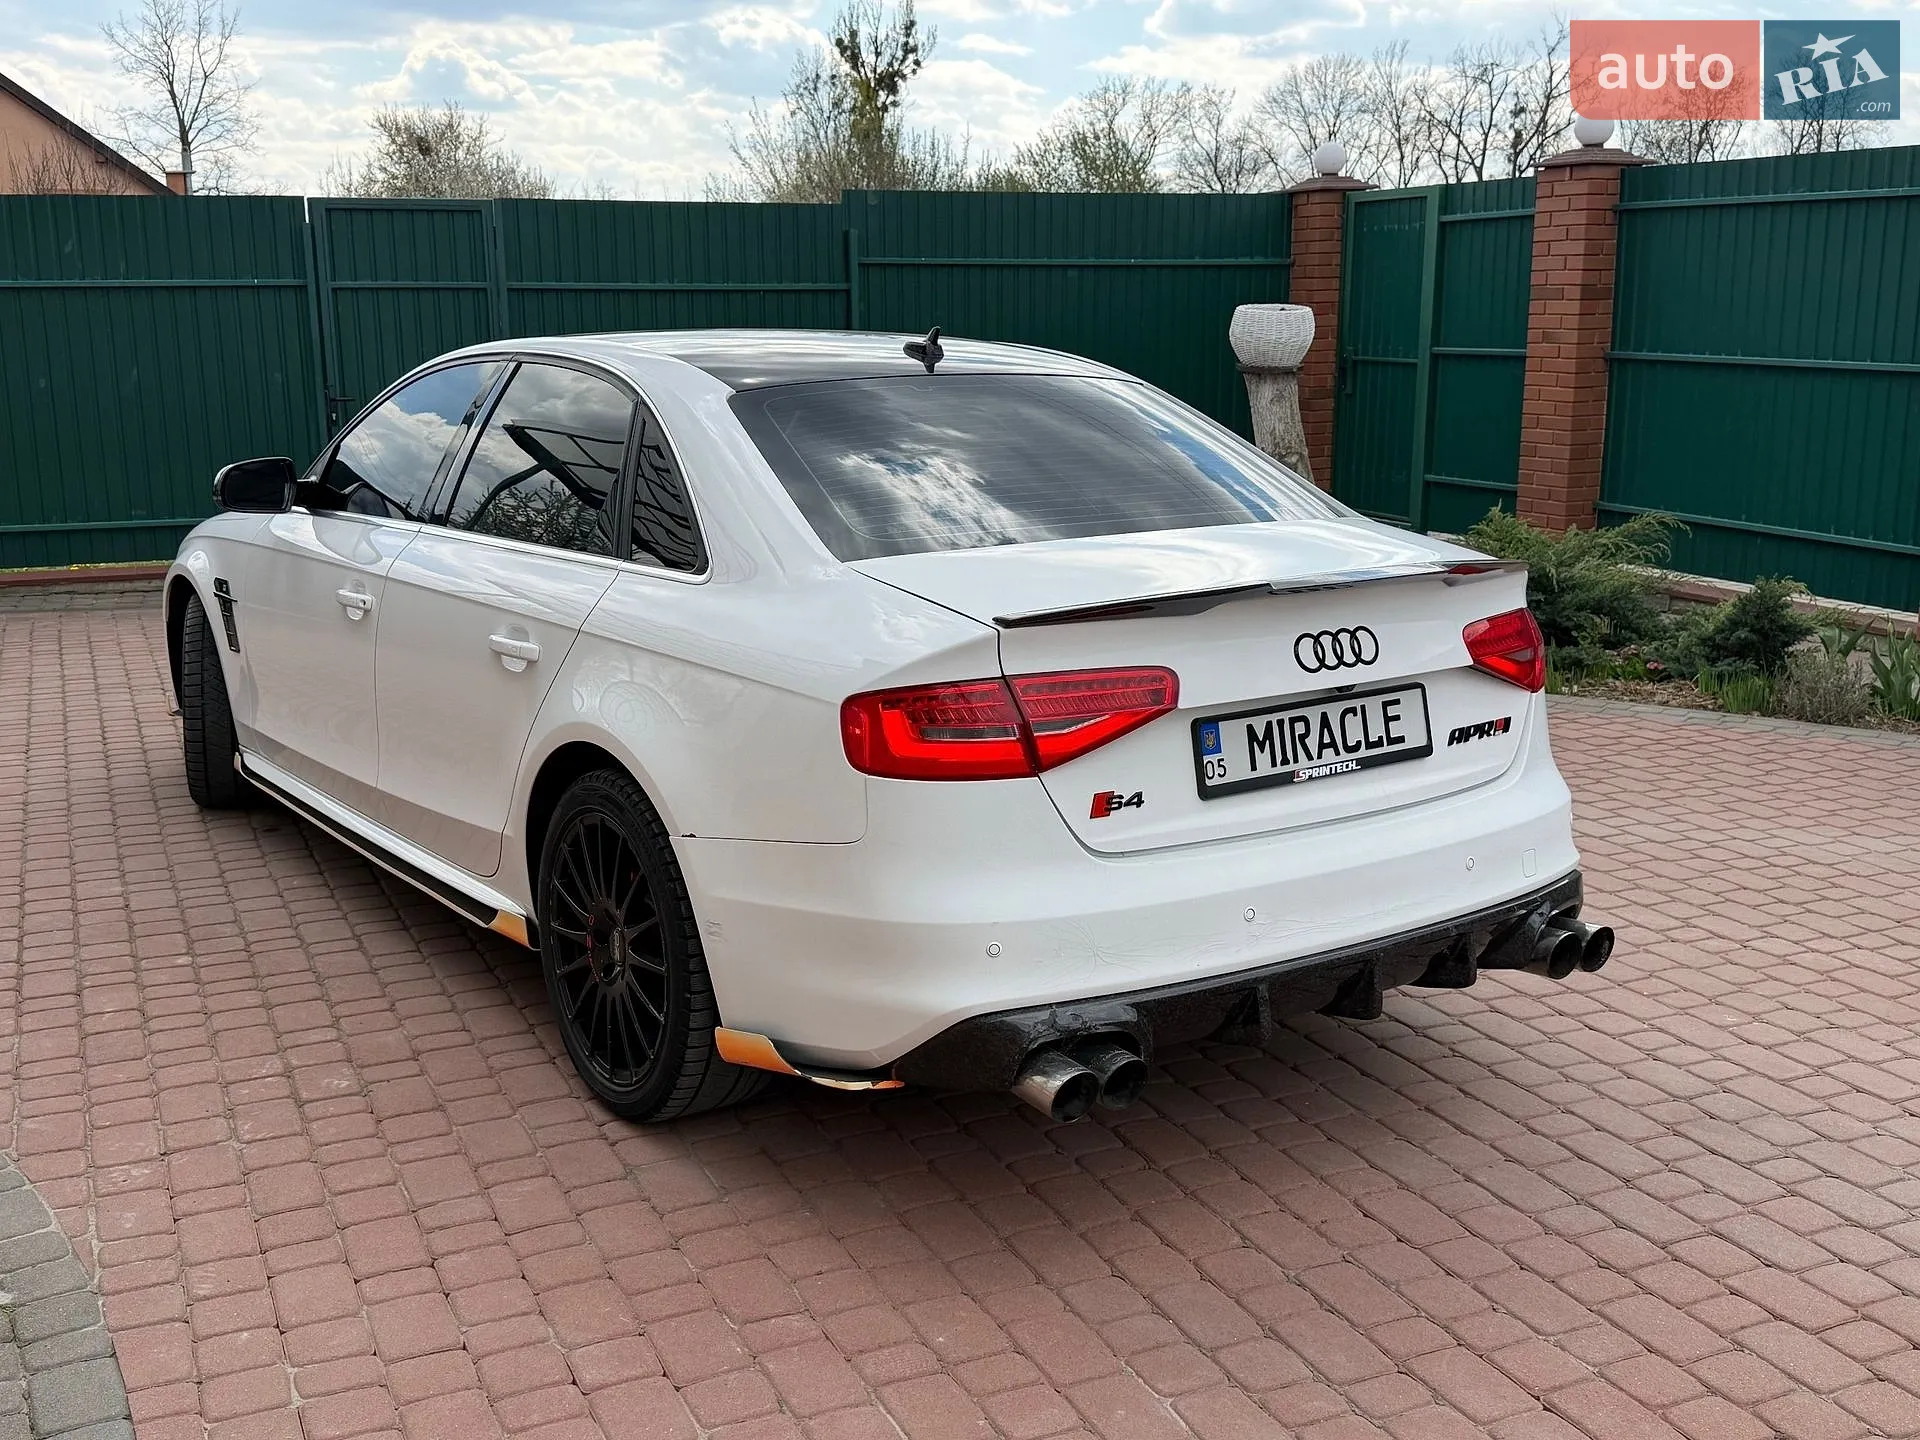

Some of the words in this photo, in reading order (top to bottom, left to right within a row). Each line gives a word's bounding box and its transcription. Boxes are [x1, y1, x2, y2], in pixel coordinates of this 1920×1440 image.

[1246, 698, 1406, 772] MIRACLE
[1204, 757, 1227, 780] 05
[1103, 791, 1145, 811] S4
